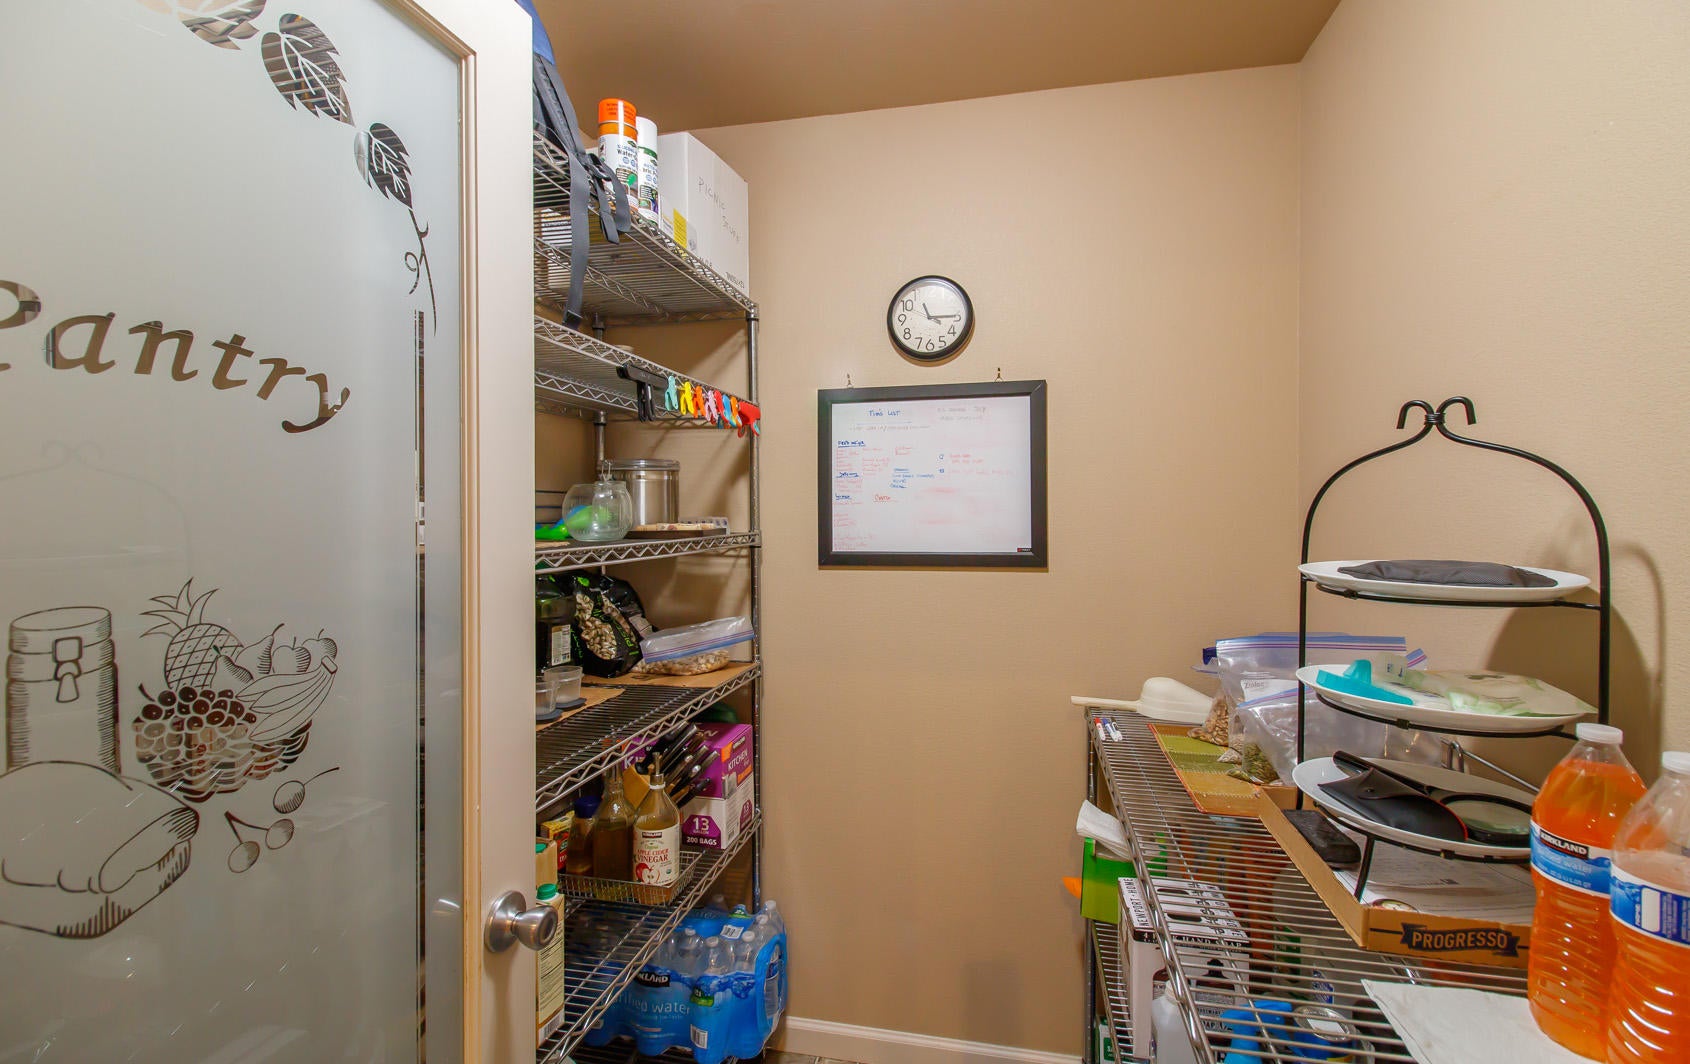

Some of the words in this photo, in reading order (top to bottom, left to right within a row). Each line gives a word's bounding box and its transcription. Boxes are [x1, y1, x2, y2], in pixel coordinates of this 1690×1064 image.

[901, 299, 914, 313] 10
[898, 313, 907, 326] 9
[903, 327, 912, 340] 8
[947, 324, 957, 337] 4
[914, 336, 923, 350] 7
[925, 338, 935, 351] 6
[938, 335, 947, 349] 5
[727, 749, 748, 771] KITCHEN
[693, 817, 710, 836] 13
[686, 836, 699, 844] 200
[699, 837, 718, 846] BAGS
[1540, 831, 1588, 855] KIRKLAND
[637, 854, 669, 863] VINEGAR
[1123, 878, 1138, 894] HOME
[1130, 897, 1150, 927] NEWPORT
[1412, 931, 1508, 950] PROGRESSO
[639, 973, 669, 984] KLAND
[652, 1001, 691, 1015] water
